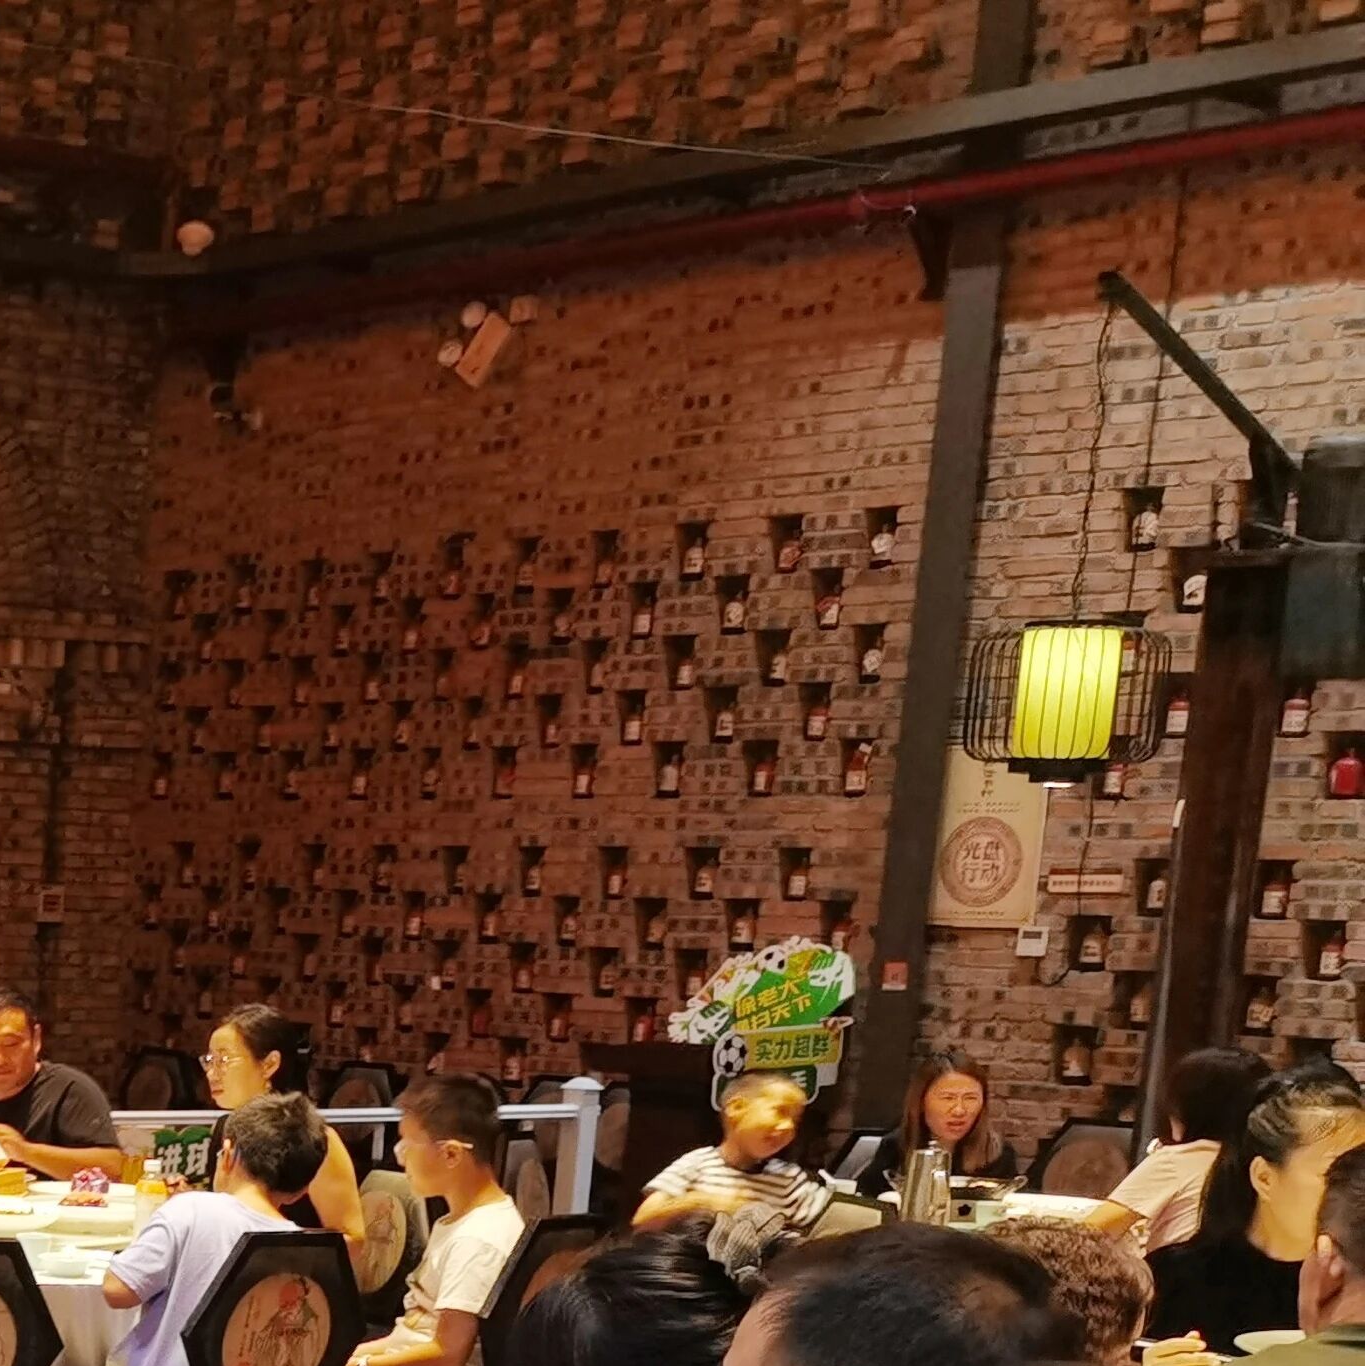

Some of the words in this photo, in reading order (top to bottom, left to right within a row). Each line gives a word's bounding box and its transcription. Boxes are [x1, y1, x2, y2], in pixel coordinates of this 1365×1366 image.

[962, 840, 1001, 860] 光盘
[961, 863, 1001, 883] 行动
[755, 1033, 830, 1062] 实力超群
